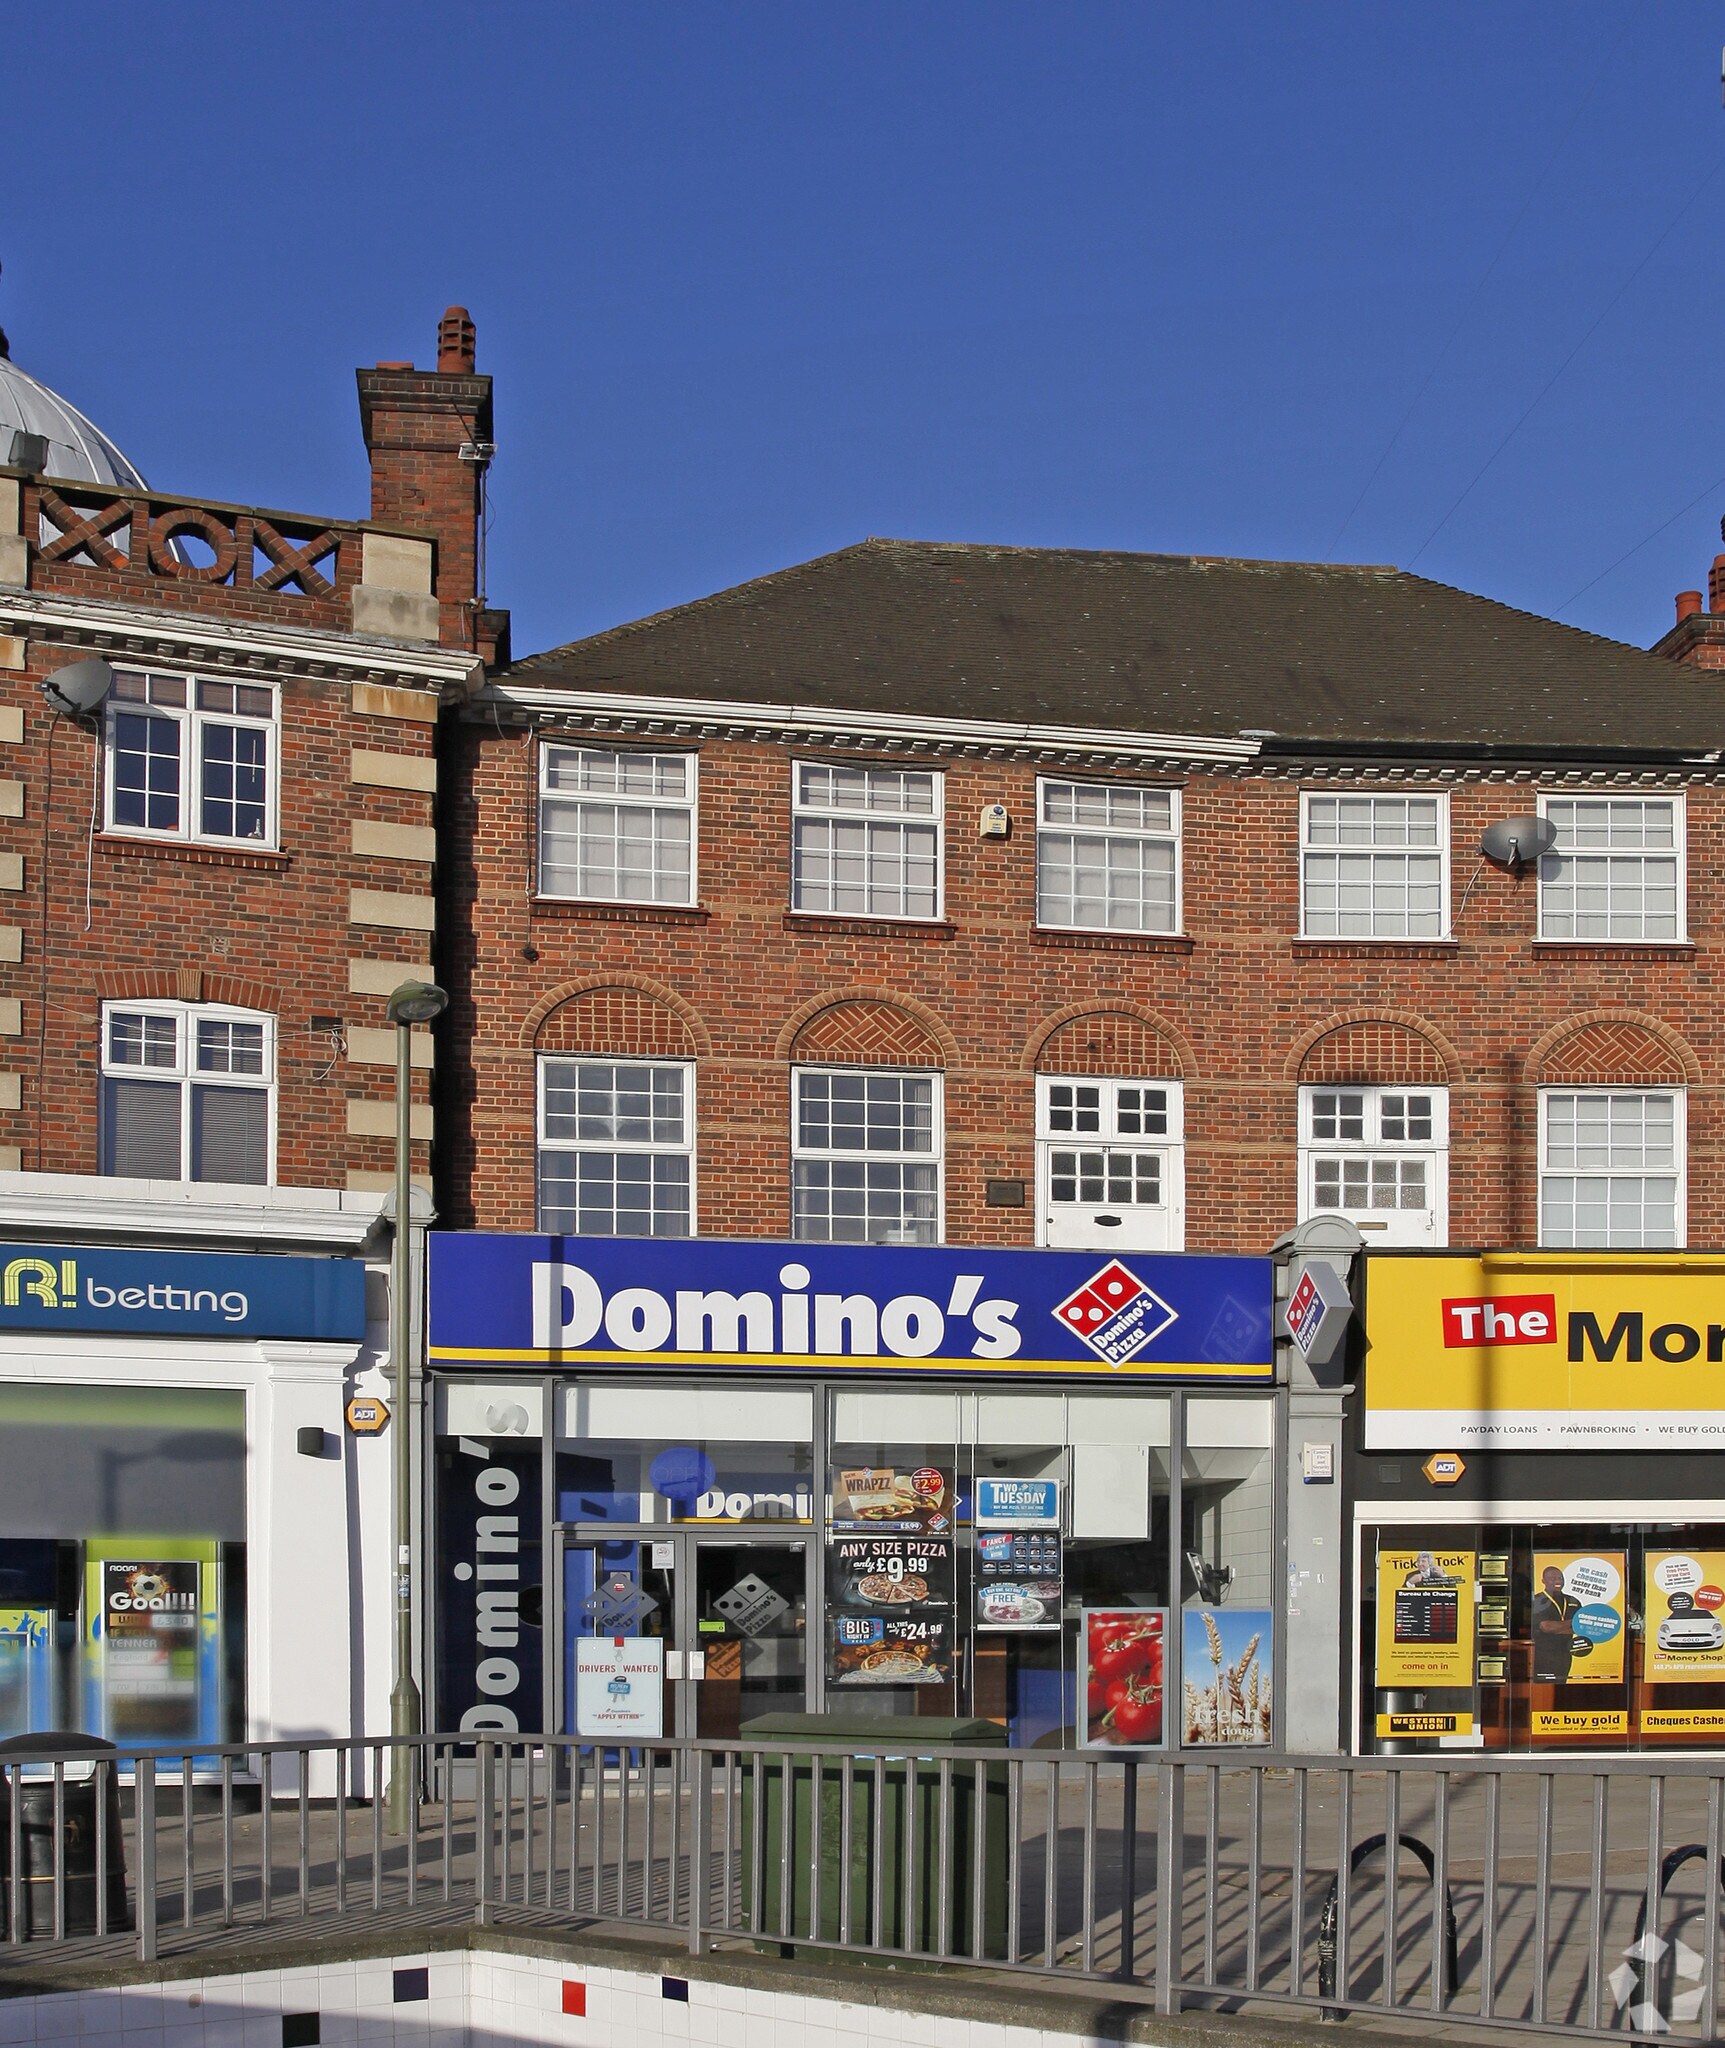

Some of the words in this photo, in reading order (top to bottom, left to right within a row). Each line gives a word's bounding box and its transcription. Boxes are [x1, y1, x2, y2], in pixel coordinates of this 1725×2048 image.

[0, 1258, 77, 1308] R!
[87, 1278, 248, 1322] betting
[532, 1262, 1022, 1359] Domino's
[1093, 1298, 1153, 1350] Domino's
[1297, 1297, 1319, 1341] Domino's
[1451, 1304, 1549, 1340] The
[1301, 1322, 1316, 1350] Pizza
[1105, 1328, 1146, 1361] Pizza
[353, 1408, 376, 1420] ADT
[1461, 1426, 1502, 1434] PAYDAY
[1504, 1426, 1538, 1434] LOANS
[1560, 1426, 1636, 1434] PAWNBROKING
[1658, 1426, 1674, 1434] WE
[1677, 1426, 1698, 1434] BUY
[653, 1465, 712, 1483] OPEN
[1436, 1462, 1456, 1473] ADT
[846, 1478, 891, 1491] WRAPZZ
[915, 1478, 941, 1490] £2.99
[1028, 1484, 1046, 1493] FOR
[990, 1487, 1046, 1504] TUESDAY
[900, 1522, 919, 1530] £5.99
[986, 1537, 1006, 1546] FANCY
[840, 1543, 868, 1557] ANY
[872, 1542, 902, 1555] SIZE
[907, 1542, 947, 1557] PIZZA
[454, 1401, 529, 1744] Domino's
[853, 1557, 875, 1572] only
[876, 1557, 928, 1583] £9.99
[1591, 1570, 1608, 1578] cash
[1571, 1579, 1591, 1588] faster
[1591, 1584, 1607, 1592] than
[1576, 1573, 1607, 1585] cheques
[993, 1594, 1016, 1603] FREE
[1584, 1589, 1601, 1597] bank
[109, 1592, 195, 1611] Goal!!!
[737, 1594, 776, 1627] Domino's
[745, 1613, 771, 1634] Pizza
[846, 1621, 870, 1634] BIG
[901, 1622, 942, 1640] £24.99
[110, 1639, 157, 1648] TENNER
[1701, 1654, 1724, 1662] Shop
[579, 1664, 616, 1673] DRIVERS
[623, 1664, 659, 1673] WANTED
[1440, 1662, 1449, 1670] in
[1194, 1702, 1261, 1724] fresh
[1540, 1716, 1559, 1724] We
[1564, 1715, 1588, 1726] buy
[1591, 1715, 1620, 1726] gold
[1647, 1716, 1691, 1726] Cheques
[1693, 1716, 1725, 1725] Cashe
[1221, 1726, 1263, 1741] dough
